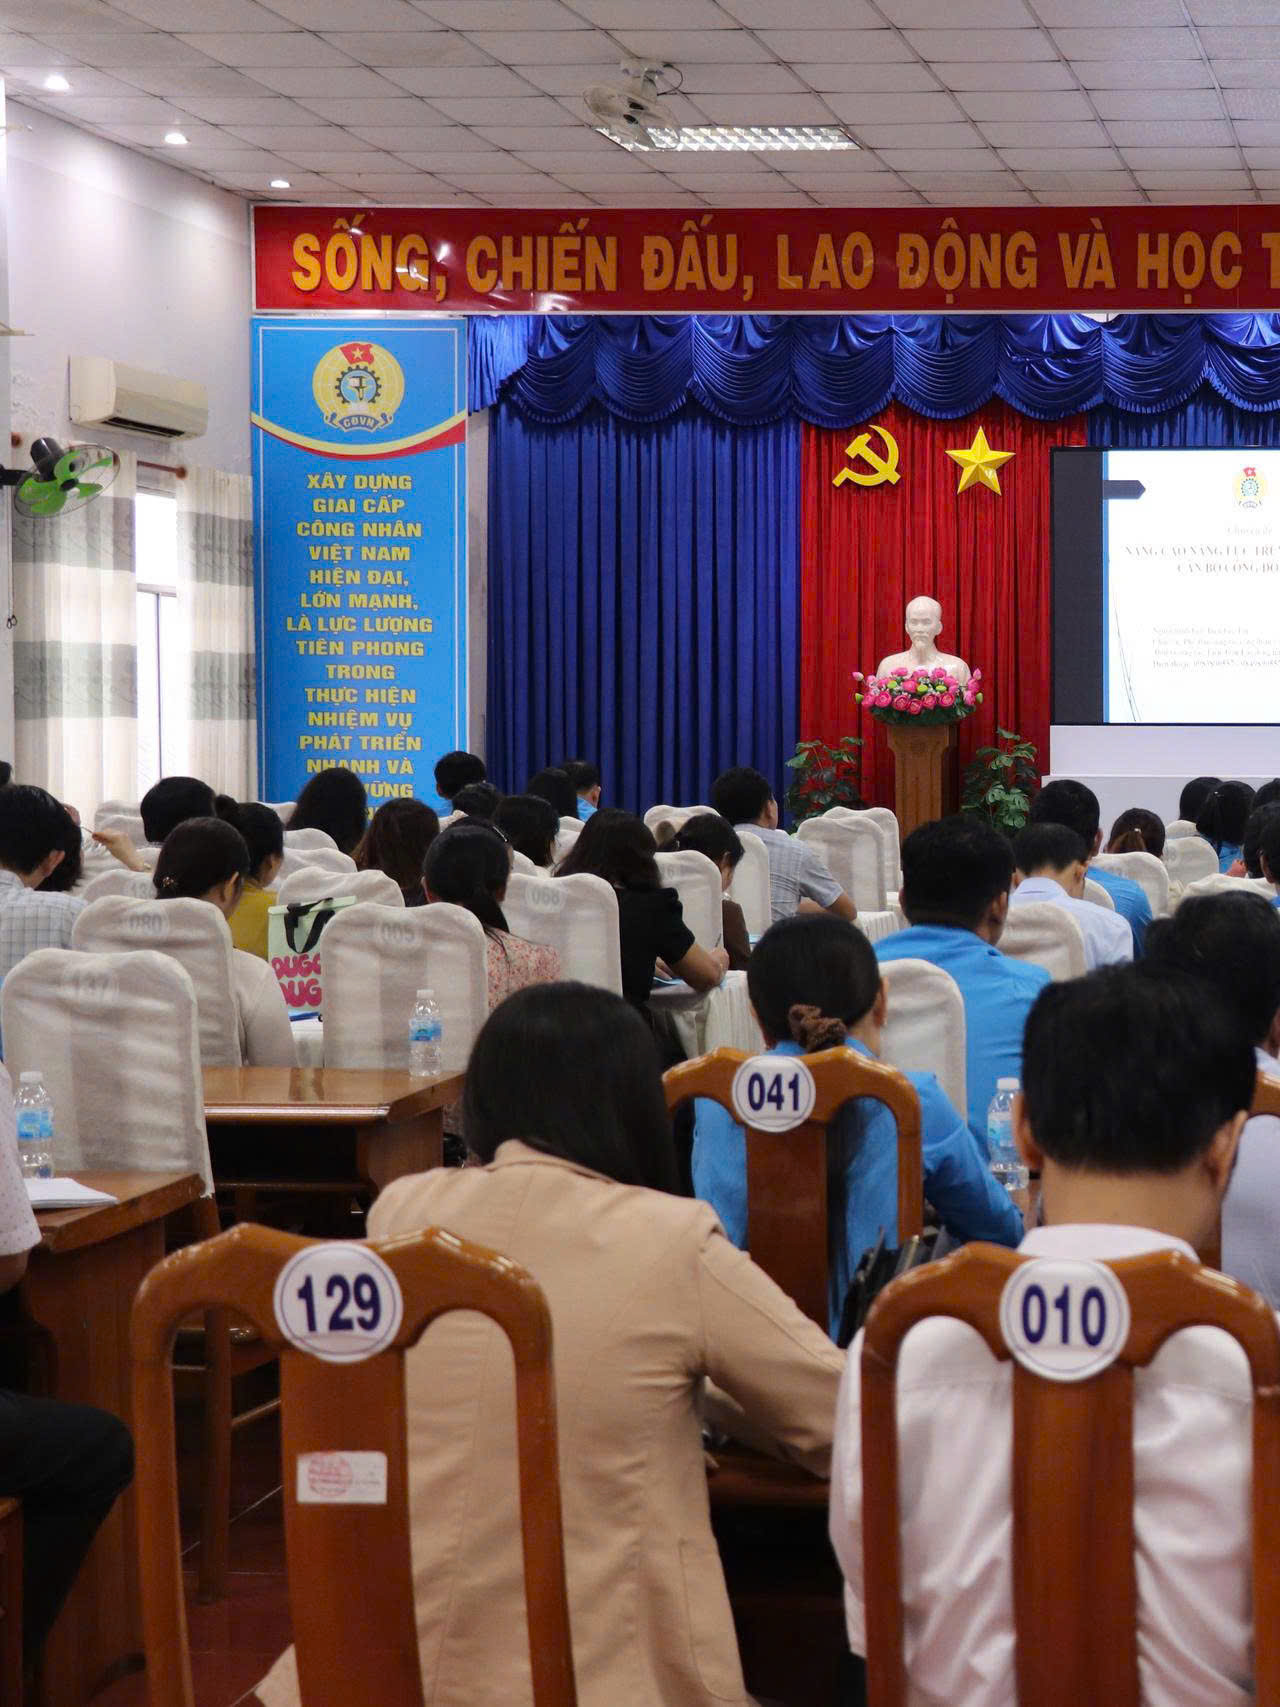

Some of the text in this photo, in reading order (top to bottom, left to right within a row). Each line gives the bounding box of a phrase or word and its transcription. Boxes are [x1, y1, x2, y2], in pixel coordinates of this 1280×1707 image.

[291, 214, 447, 301] SỐNG,
[465, 217, 617, 293] CHIẾN
[641, 214, 754, 301] ĐẤU,
[777, 231, 874, 289] LAO
[896, 217, 1038, 303] ĐỘNG
[1058, 218, 1116, 289] VÀ
[1137, 231, 1242, 304] HỌC
[307, 472, 412, 492] XÂY DỰNG
[313, 495, 405, 513] GIAI CẤP
[296, 520, 422, 537] CÔNG NHÂN
[309, 544, 410, 563] VIỆT NAM
[310, 567, 409, 587] HIỆN ĐẠI,
[301, 591, 419, 611] LỚN MẠNH,
[287, 614, 432, 636] LÀ LỰC LƯỢNG
[296, 638, 424, 656] TIÊN PHONG
[326, 664, 395, 679] TRONG
[304, 686, 416, 706] THỰC HIỆN
[308, 710, 413, 729] NHIỆM VỤ
[300, 730, 421, 750] PHÁT TRIỂN
[387, 757, 413, 774] VÀ
[748, 1072, 800, 1112] 041
[297, 1273, 381, 1332] 129
[1021, 1284, 1107, 1347] 010
